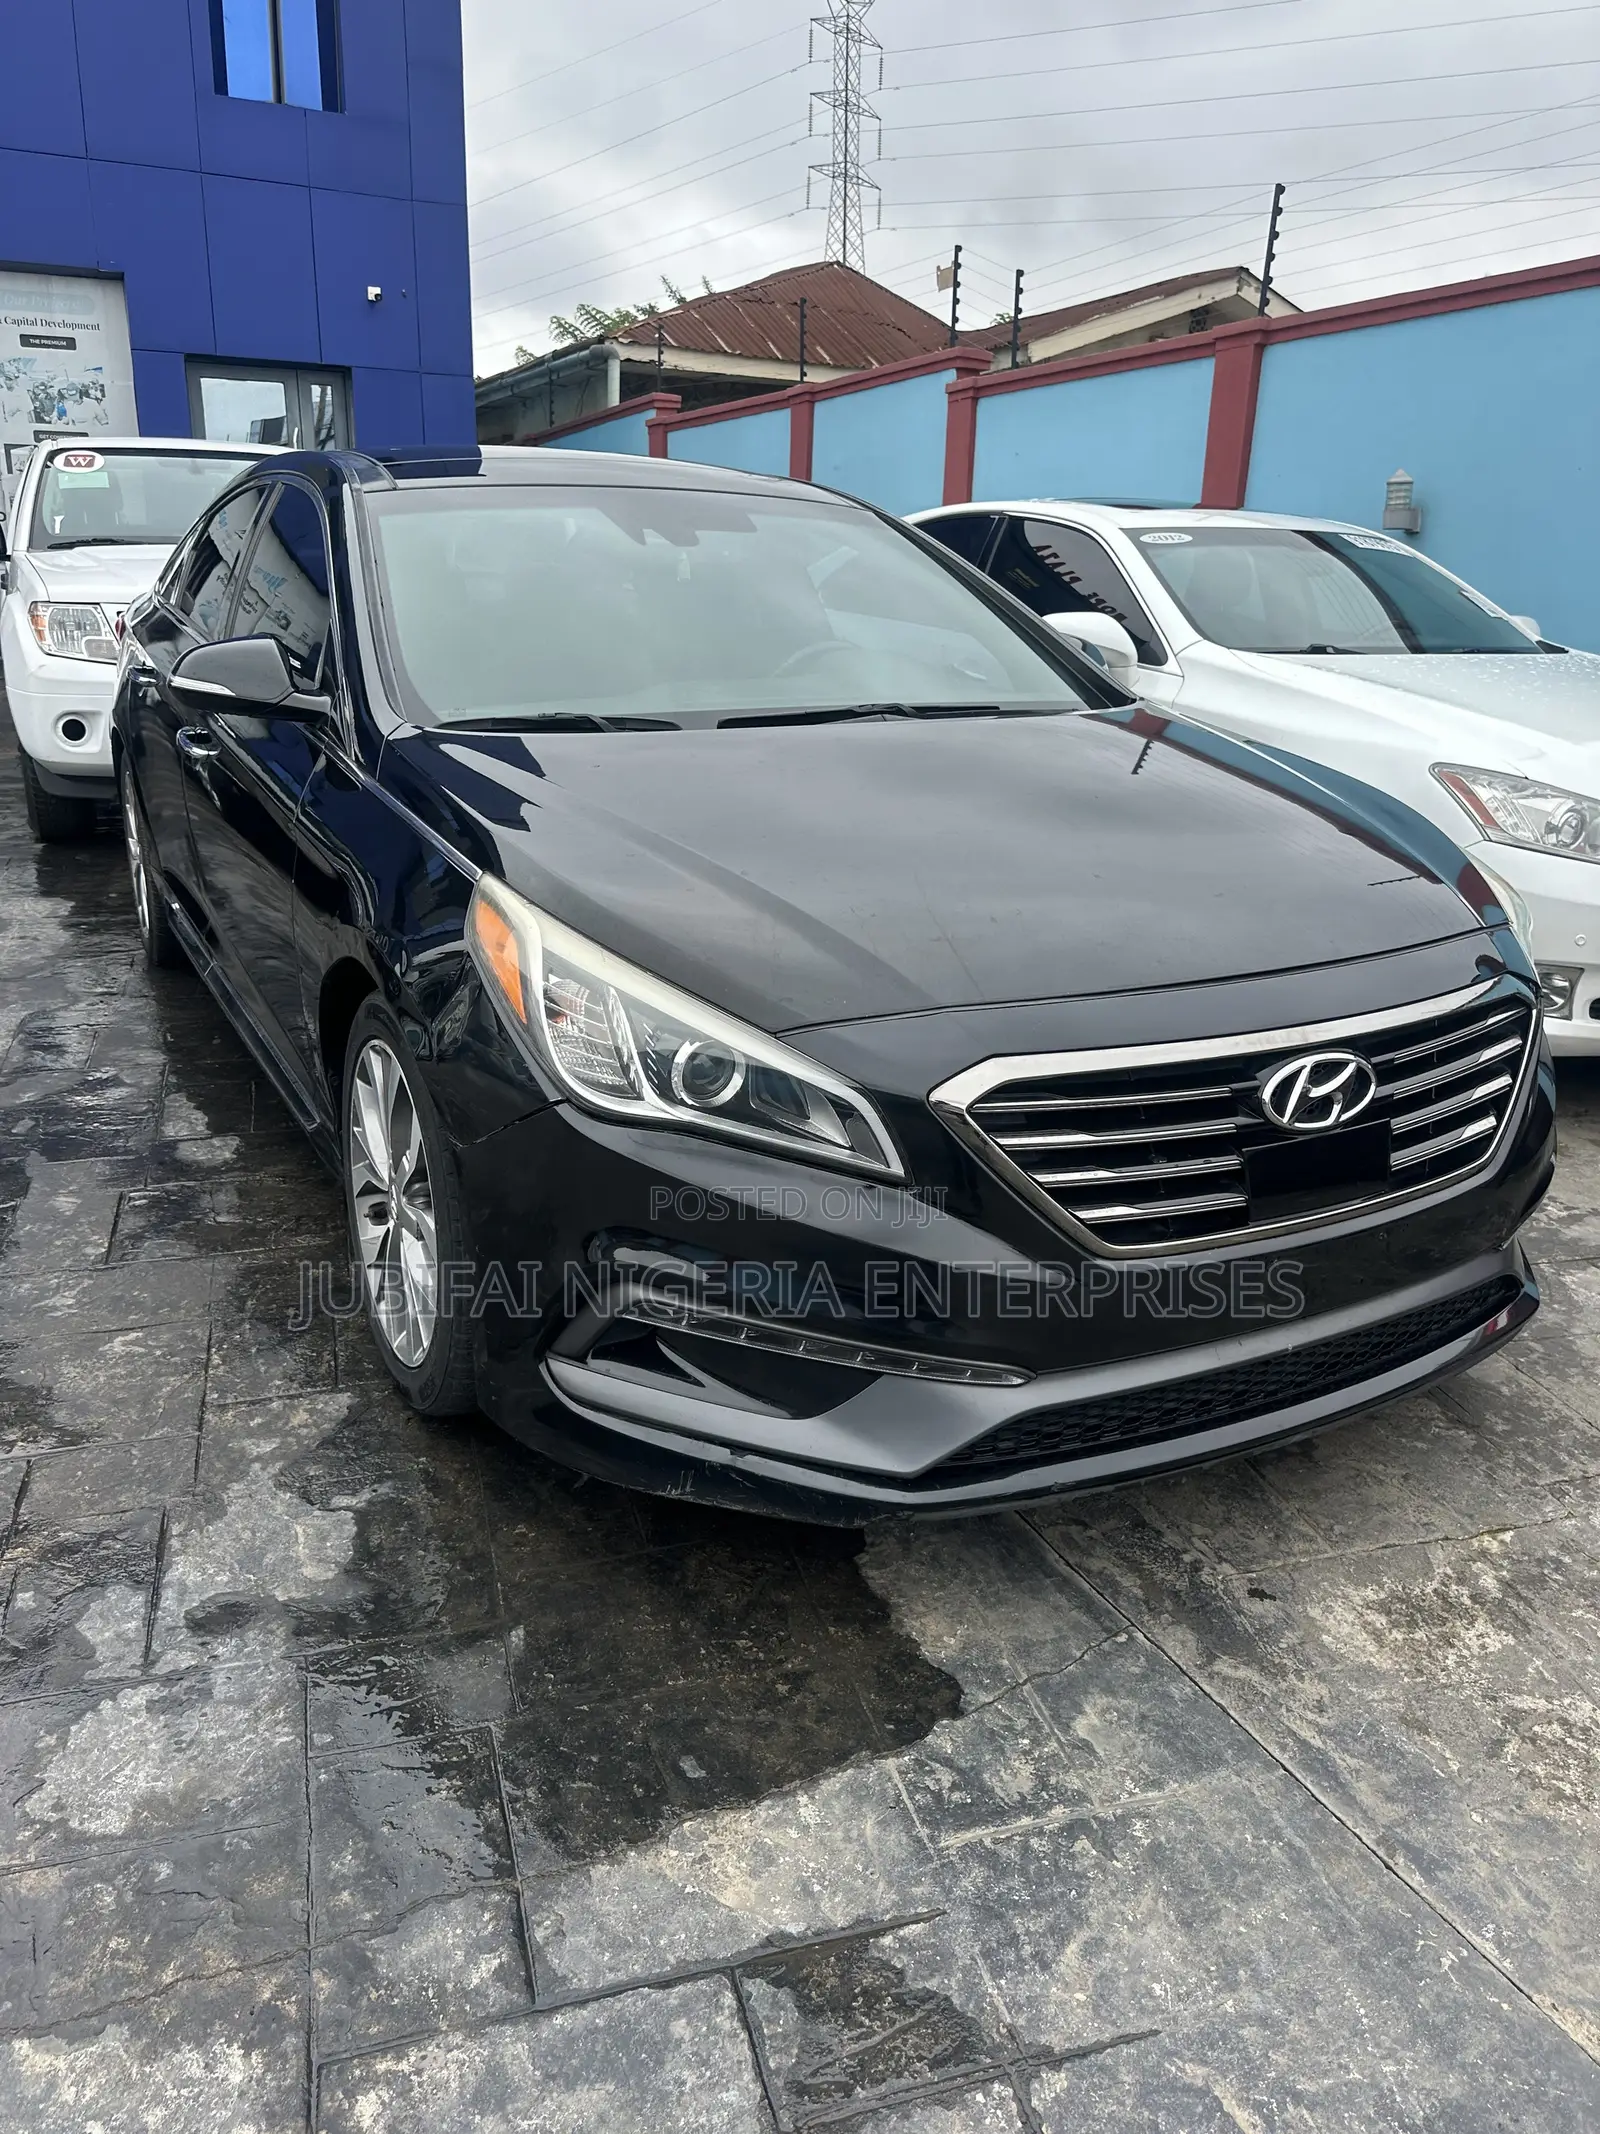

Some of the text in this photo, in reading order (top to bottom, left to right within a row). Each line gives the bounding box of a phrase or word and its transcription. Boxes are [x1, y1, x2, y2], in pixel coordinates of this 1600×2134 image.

[4, 316, 38, 328] Capital
[40, 318, 101, 331] Development
[1147, 534, 1185, 542] 2012
